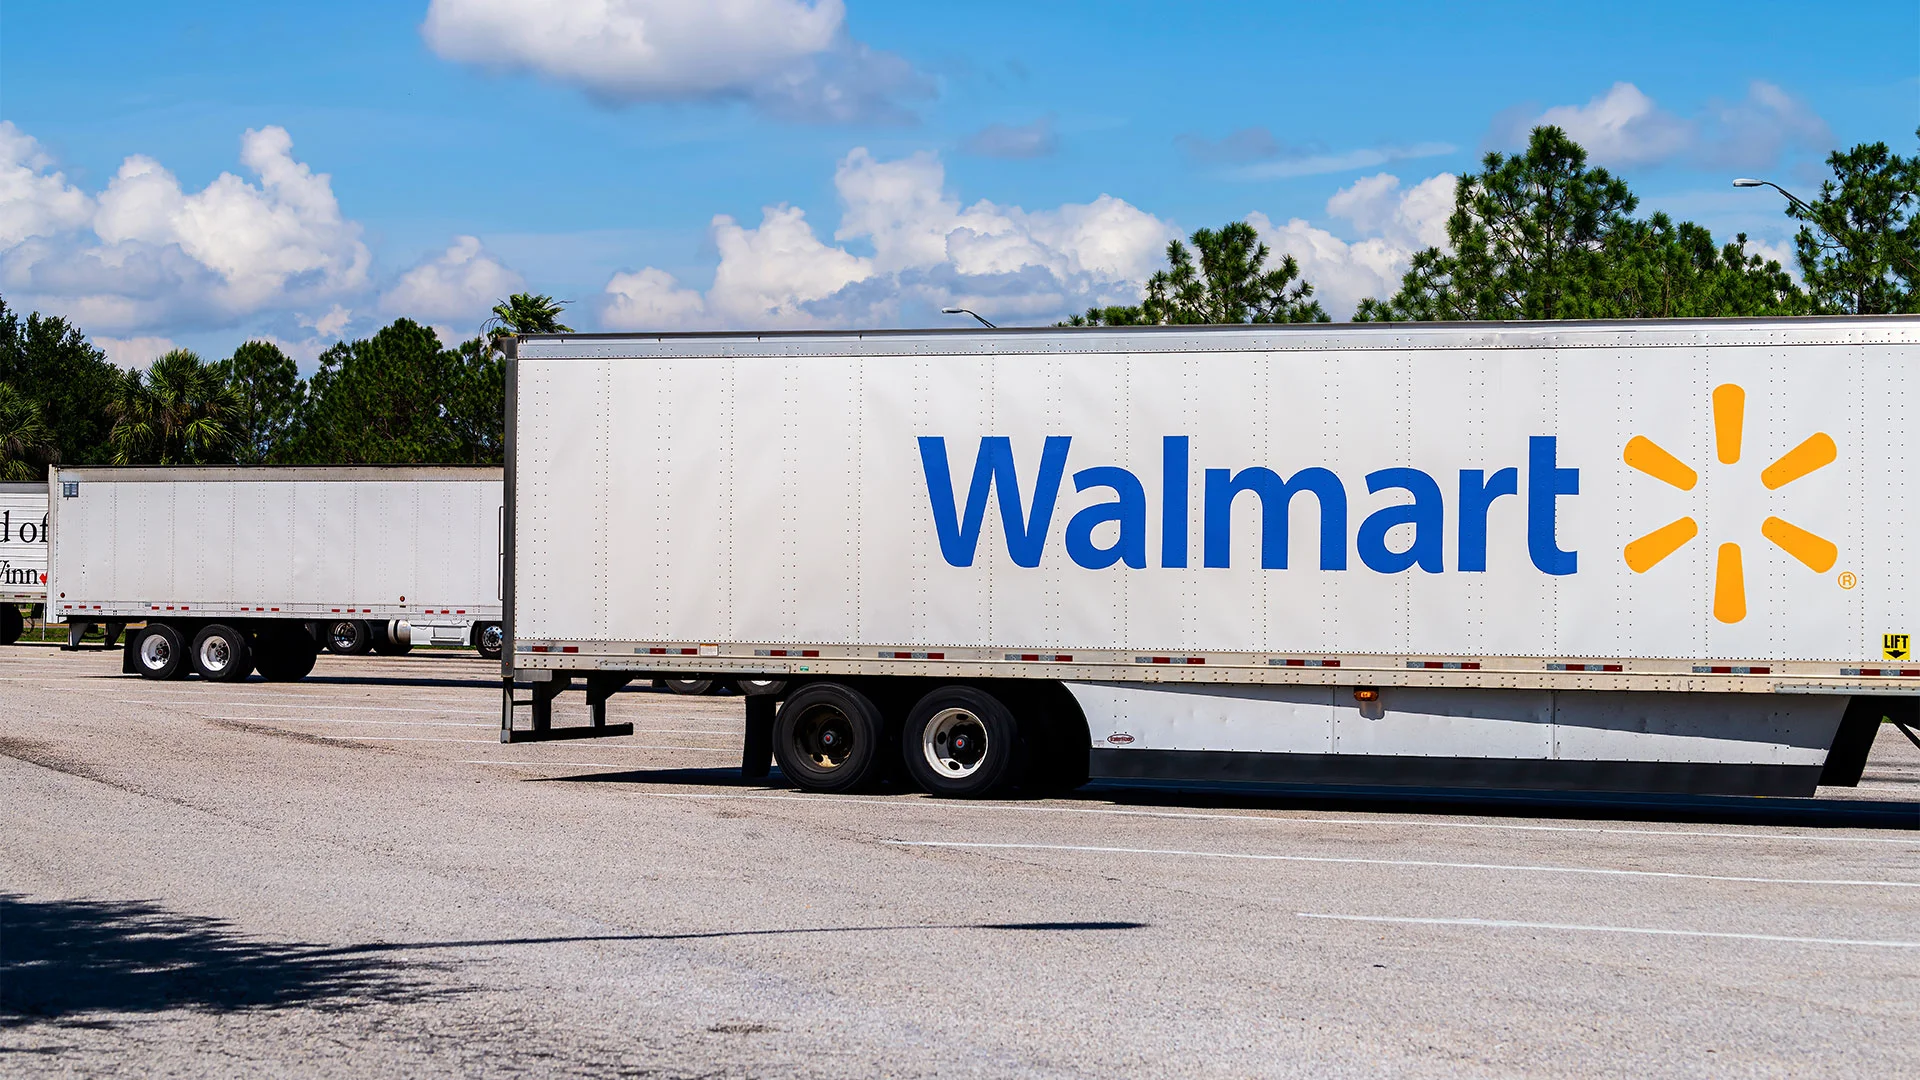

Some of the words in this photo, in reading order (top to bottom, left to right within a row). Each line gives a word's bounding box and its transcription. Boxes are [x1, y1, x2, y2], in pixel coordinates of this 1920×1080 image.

[917, 436, 1580, 576] Walmart
[19, 511, 48, 543] of
[1884, 634, 1909, 649] LIFT
